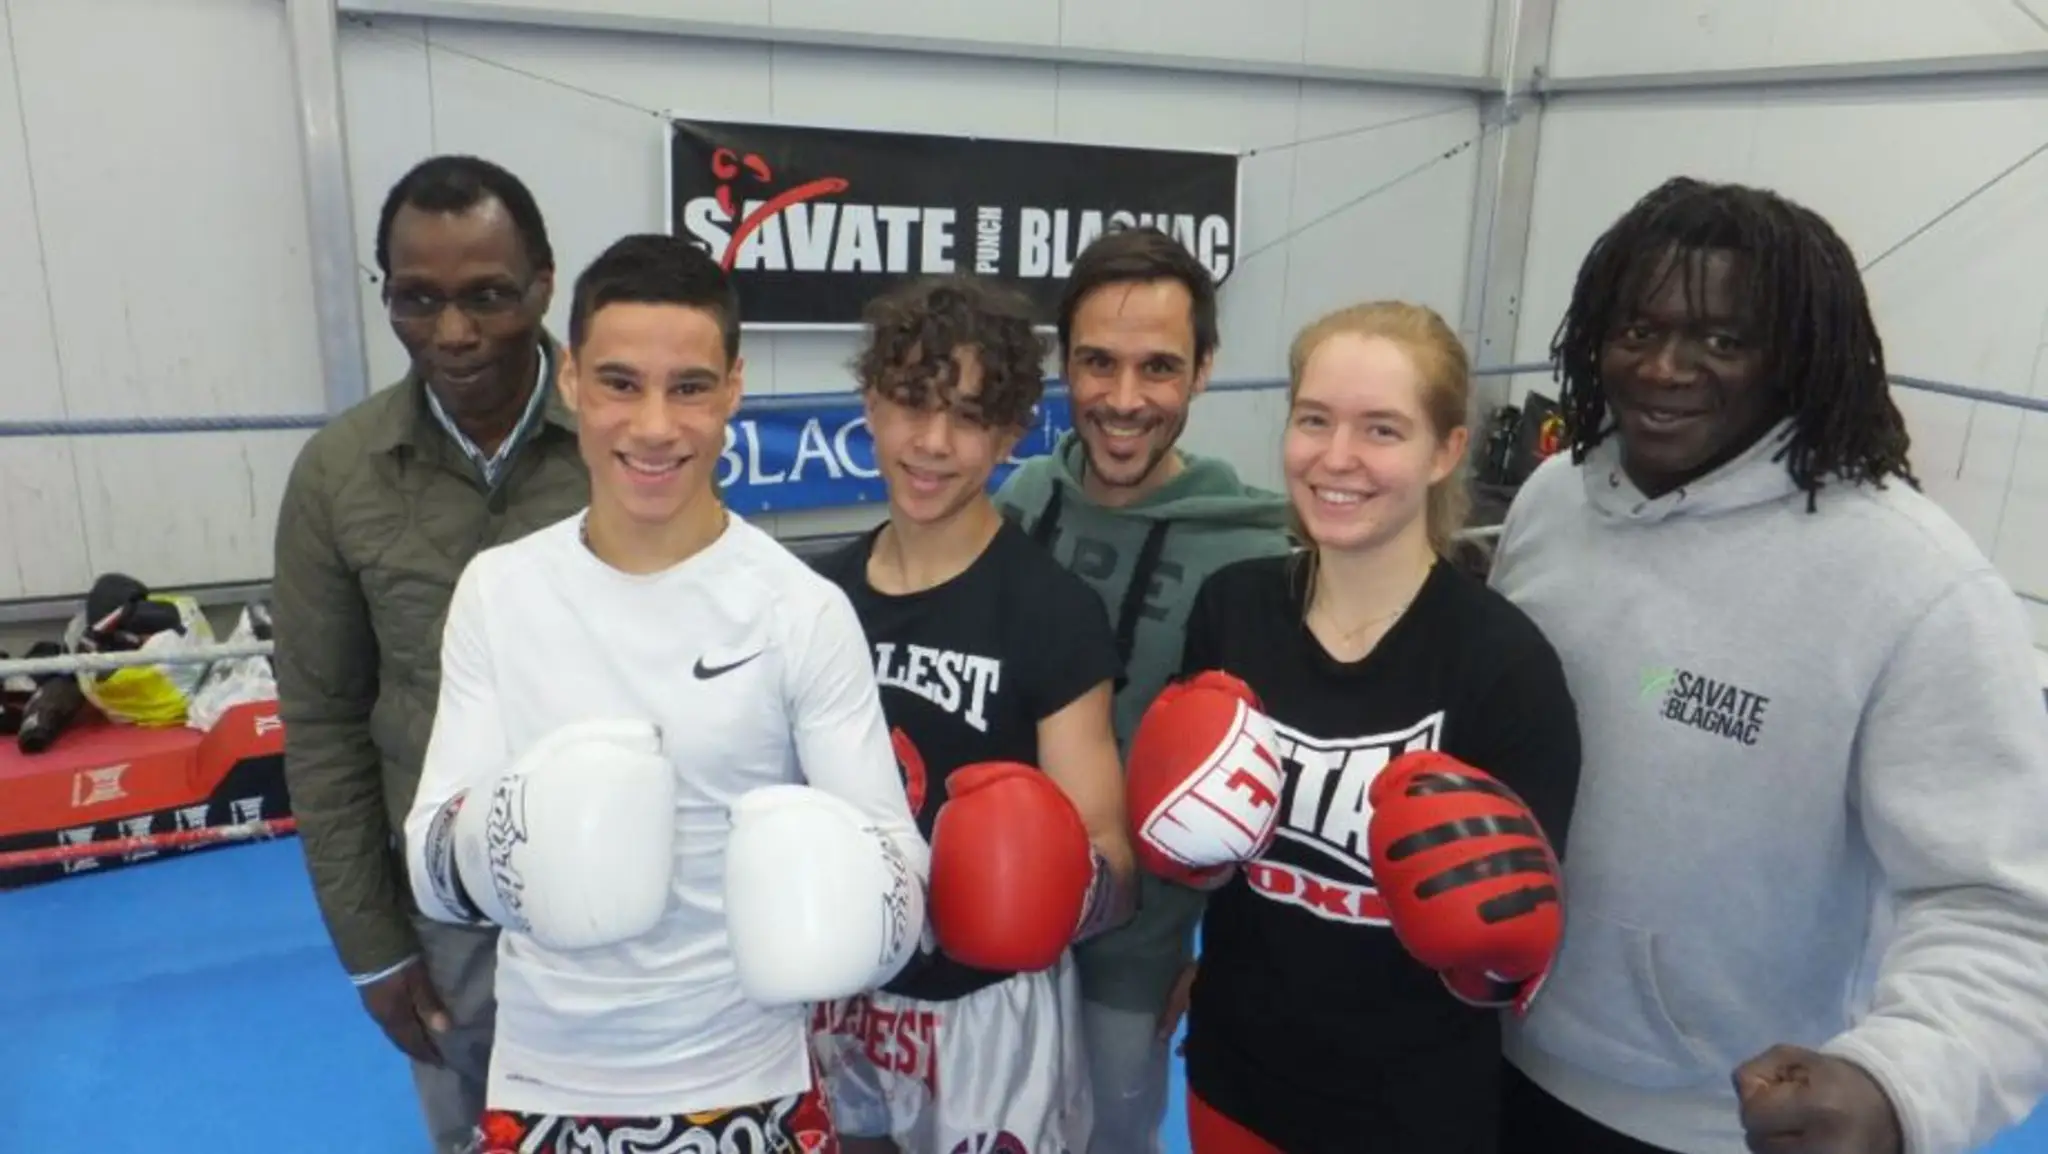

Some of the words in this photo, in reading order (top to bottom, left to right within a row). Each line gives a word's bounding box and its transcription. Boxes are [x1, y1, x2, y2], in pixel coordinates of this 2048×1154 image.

[684, 196, 956, 273] SAVATE
[975, 206, 1002, 274] PUNCH
[1018, 207, 1230, 282] BLAAC
[1664, 697, 1761, 746] BLAGNAC
[1673, 670, 1771, 726] SAVATE
